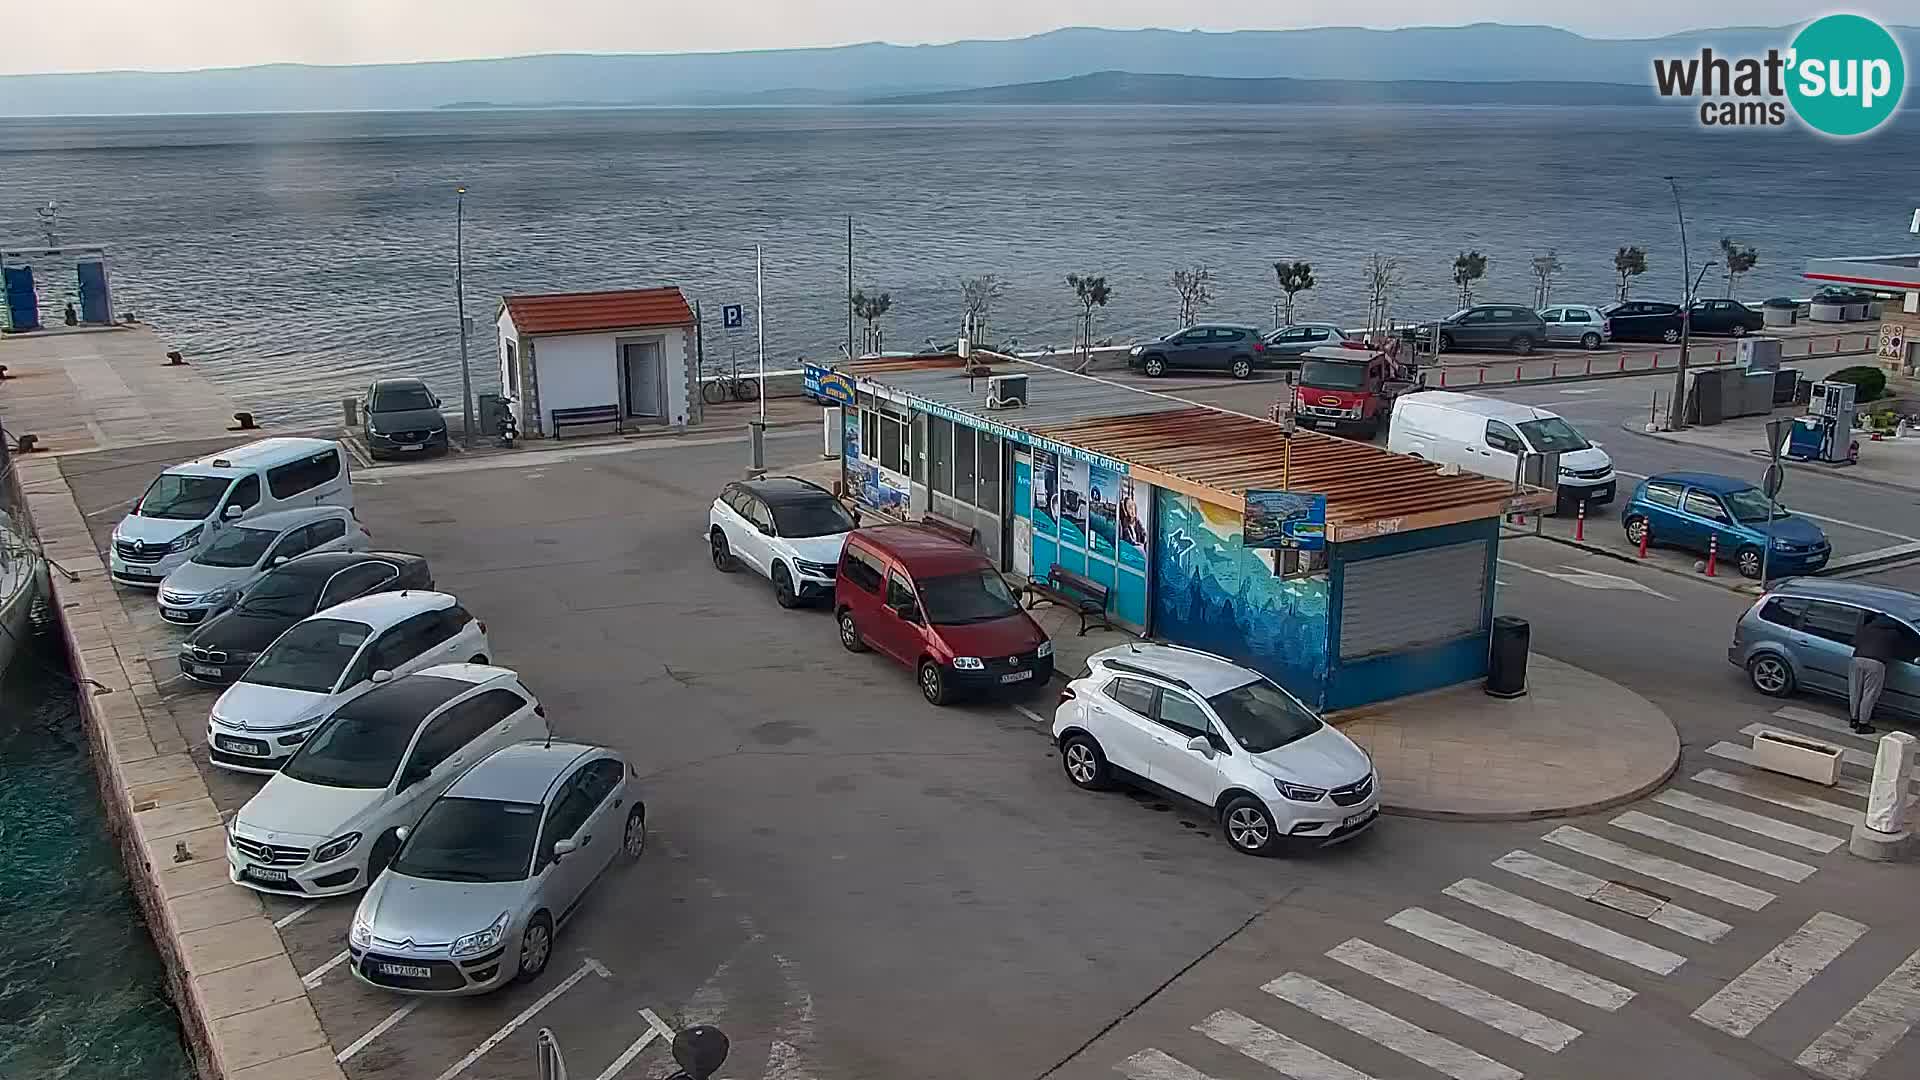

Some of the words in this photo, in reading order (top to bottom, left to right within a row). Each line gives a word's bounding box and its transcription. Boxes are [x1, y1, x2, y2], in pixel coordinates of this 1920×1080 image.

[727, 308, 738, 325] P
[910, 398, 933, 413] PRODAJA
[933, 406, 953, 419] KARATA
[953, 411, 990, 431] AUTOBUSNA
[990, 425, 1019, 441] POSTAJA
[1028, 435, 1042, 449] BUS
[1042, 440, 1073, 457] STATION
[1074, 449, 1099, 465] TICKET
[1100, 456, 1125, 473] OFFICE
